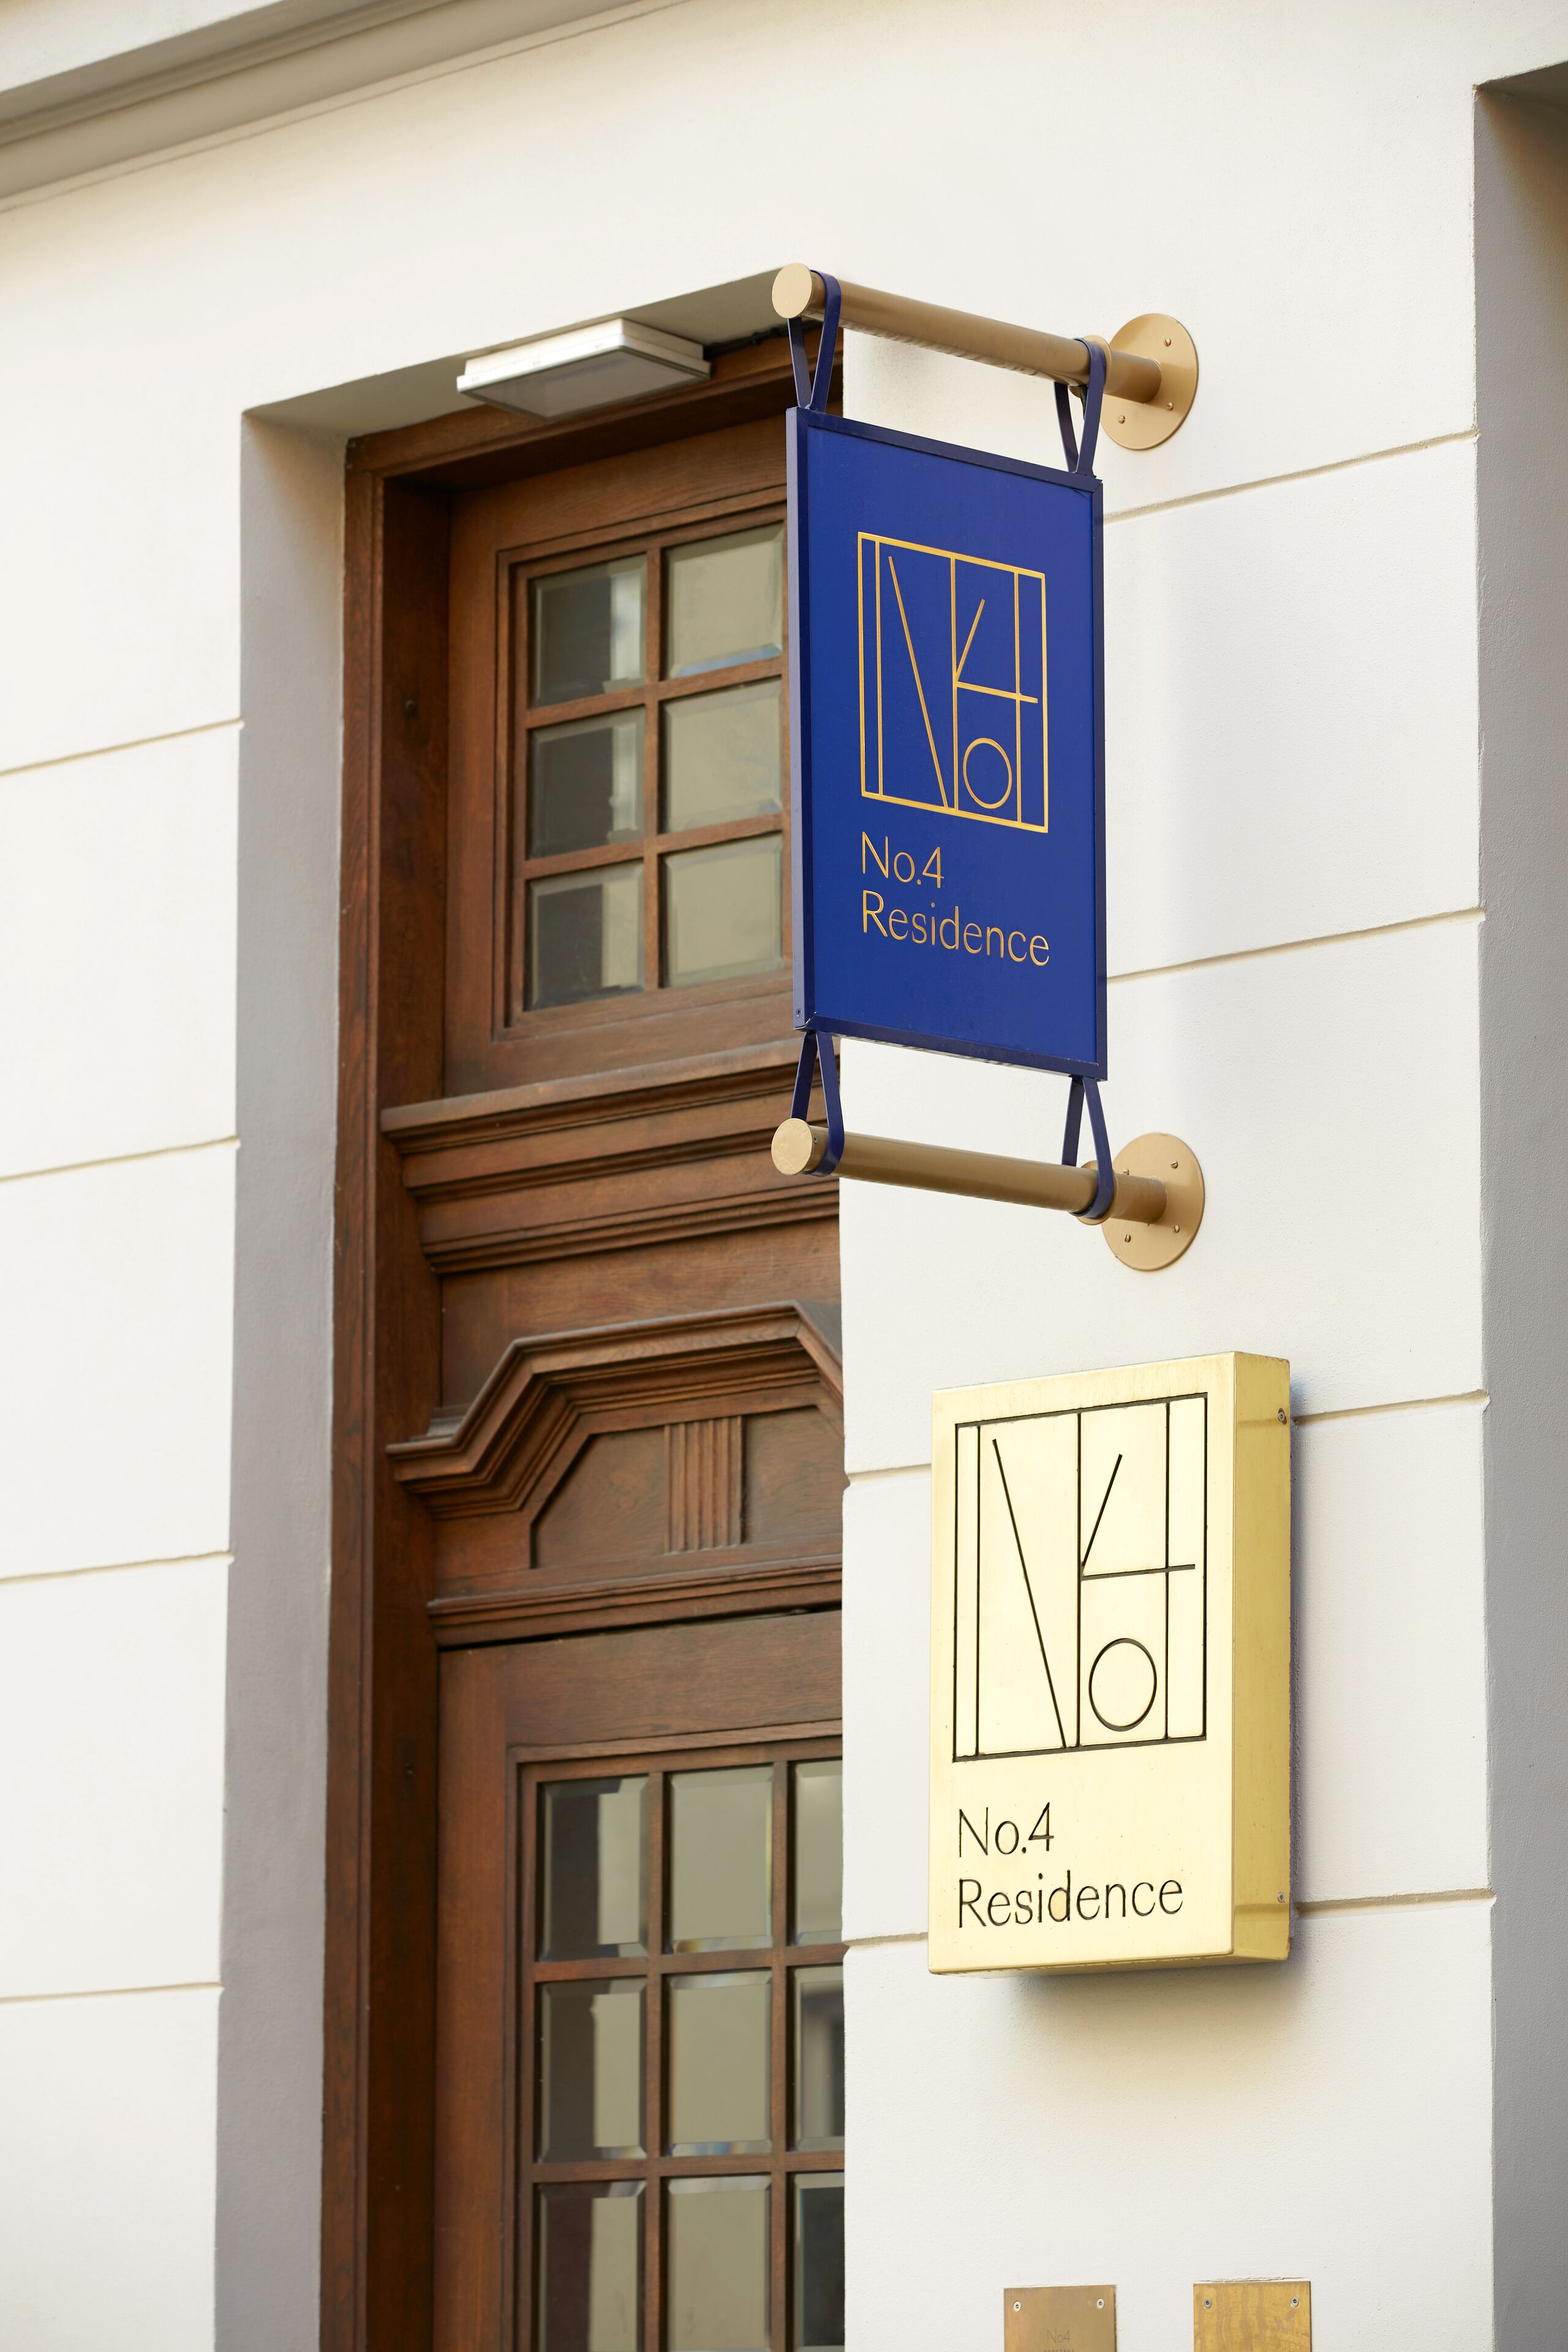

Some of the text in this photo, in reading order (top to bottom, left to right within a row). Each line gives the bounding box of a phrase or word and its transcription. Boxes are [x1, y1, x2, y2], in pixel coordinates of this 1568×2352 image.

[862, 831, 944, 889] No.4
[862, 889, 1049, 967] Residence
[959, 1801, 1054, 1858] No.4
[959, 1869, 1183, 1929] Residence
[1046, 2328, 1070, 2343] No4
